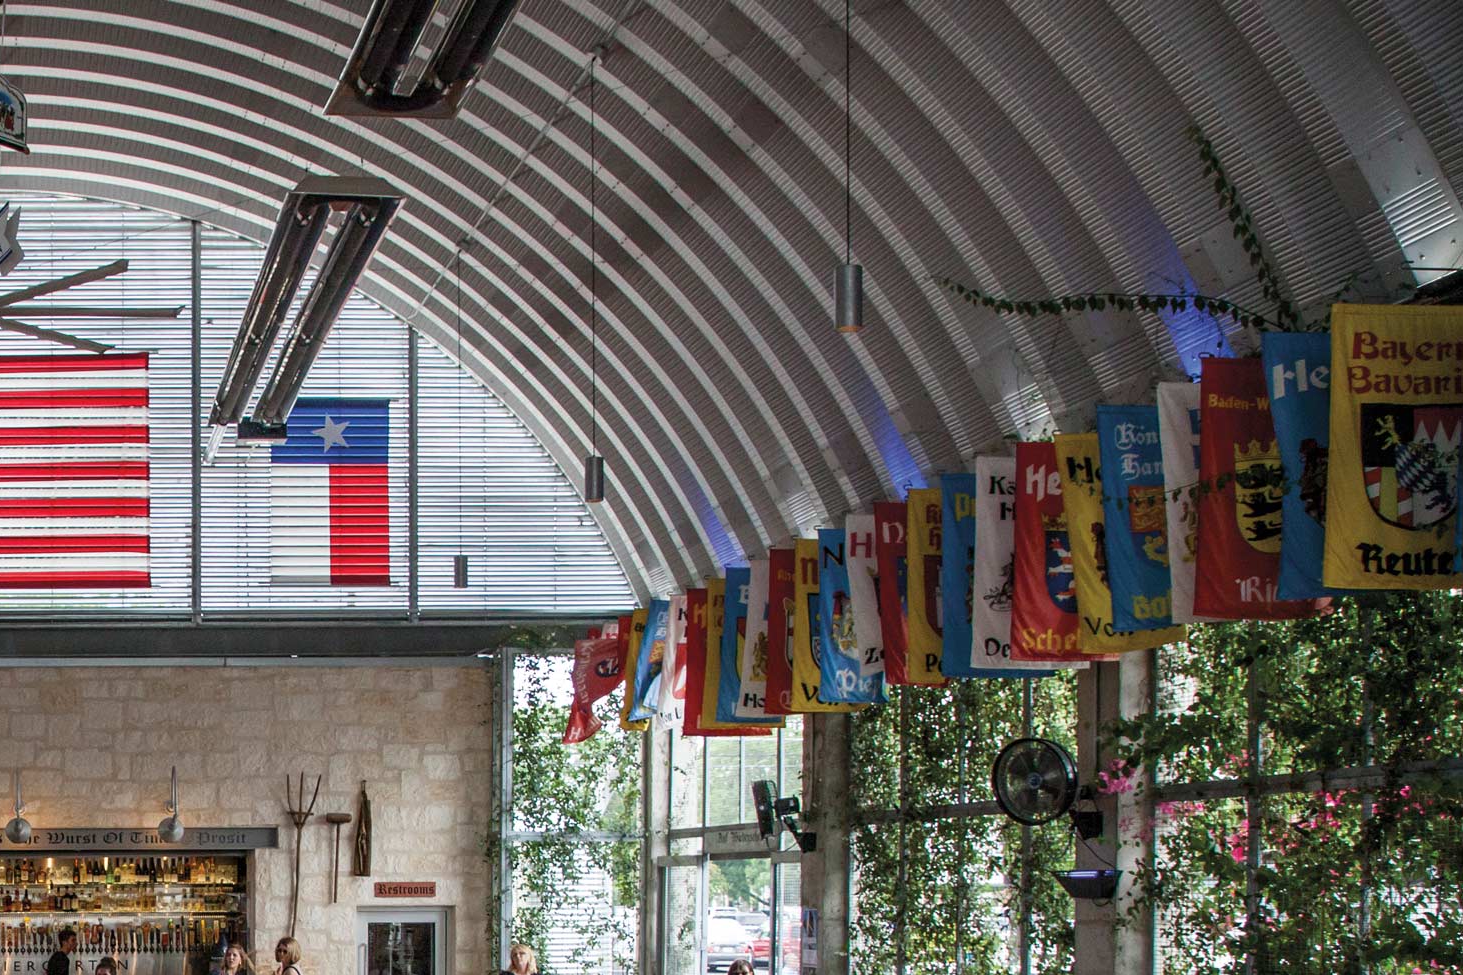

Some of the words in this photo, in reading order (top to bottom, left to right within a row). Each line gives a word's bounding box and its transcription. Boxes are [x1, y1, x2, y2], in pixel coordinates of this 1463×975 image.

[47, 832, 96, 845] Wurst
[103, 832, 123, 844] Of
[197, 832, 246, 846] Prosit
[378, 883, 435, 895] Restrooms
